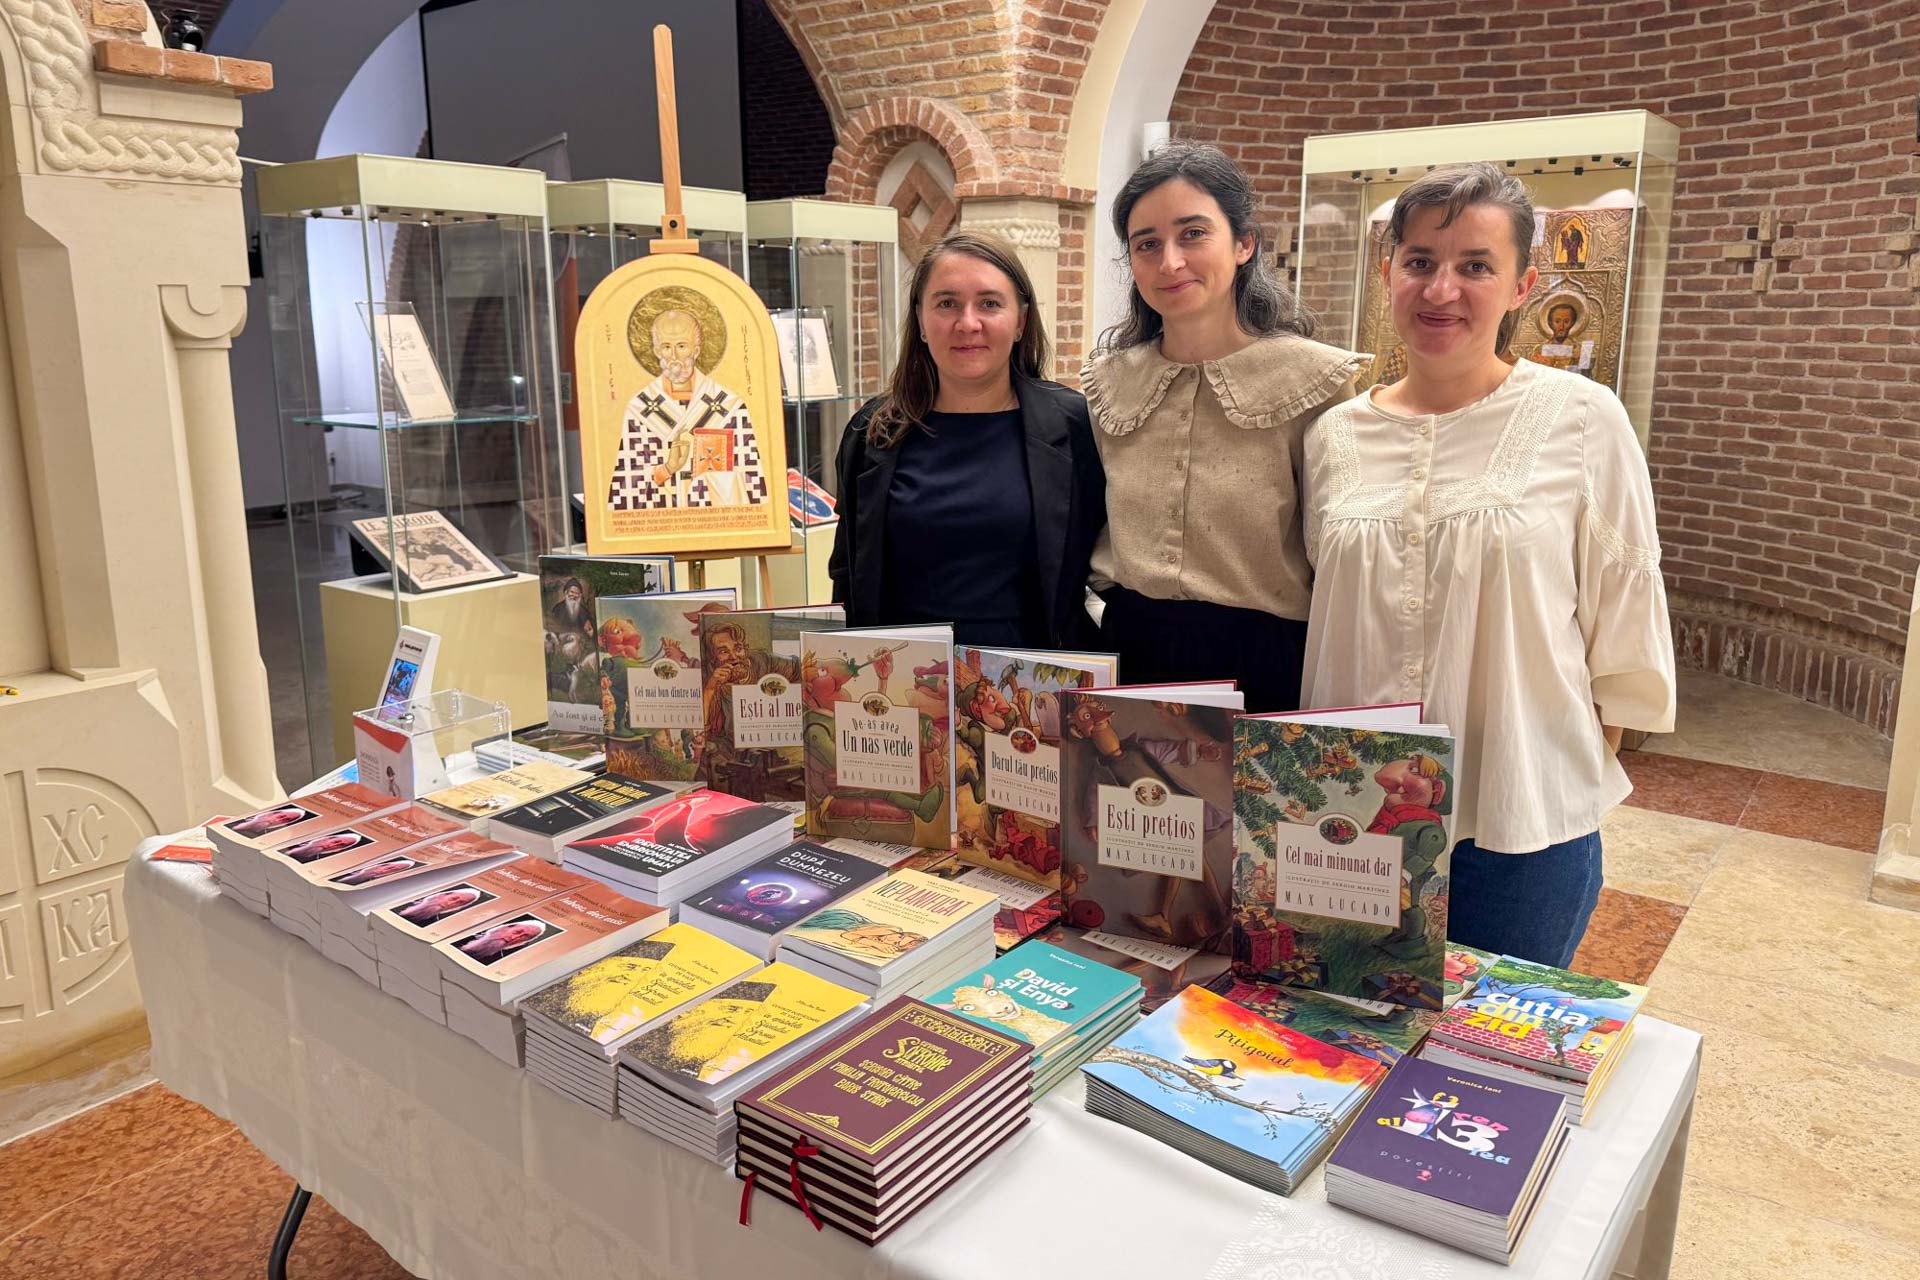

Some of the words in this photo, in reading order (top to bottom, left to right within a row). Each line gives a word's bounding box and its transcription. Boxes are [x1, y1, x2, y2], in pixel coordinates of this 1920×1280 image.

[634, 686, 644, 698] Cel
[645, 686, 656, 698] mai
[658, 686, 669, 698] bun
[671, 686, 689, 698] dintre
[740, 699, 763, 720] Ești
[769, 698, 779, 718] al
[785, 702, 801, 717] me
[741, 733, 760, 742] MAX
[771, 732, 803, 742] LUCA
[881, 720, 899, 734] avea
[843, 730, 857, 752] Un
[861, 736, 880, 754] nas
[884, 736, 913, 757] verde
[992, 751, 1013, 773] Darul
[1015, 759, 1028, 777] tău
[843, 770, 863, 782] MAX
[873, 772, 914, 786] LUCADO
[992, 788, 1010, 803] MAX
[1019, 796, 1058, 815] LUCADO
[1107, 804, 1136, 833] Ești
[1142, 813, 1196, 840] prețios
[616, 840, 685, 864] EMBRIONULUI
[631, 838, 692, 860] IDENTITATEA
[791, 851, 827, 866] DUPĂ
[1106, 847, 1130, 861] MAX
[1142, 852, 1195, 872] LUCADO
[1286, 845, 1301, 864] Cel
[1304, 849, 1323, 868] mai
[1326, 852, 1372, 874] minunat
[1374, 857, 1392, 877] dar
[642, 856, 675, 869] UMAN
[779, 856, 852, 883] DUMNEZEU
[872, 880, 974, 917] NEPLANIFICAT
[1286, 890, 1314, 906] MAX
[1328, 896, 1390, 917] LUCADO
[1013, 968, 1079, 997] David
[1017, 982, 1069, 1011] Enya
[1462, 1012, 1533, 1038] zid
[1477, 1003, 1544, 1029] din
[883, 1036, 953, 1072] SOFRONIE
[1215, 1028, 1294, 1068] Pițigoiul
[829, 1062, 866, 1080] FAMILIA
[1447, 1076, 1483, 1089] Veronica
[833, 1078, 862, 1094] BORIS
[860, 1090, 893, 1108] STARK
[1377, 1117, 1401, 1127] al
[1380, 1150, 1472, 1180] povestiri
